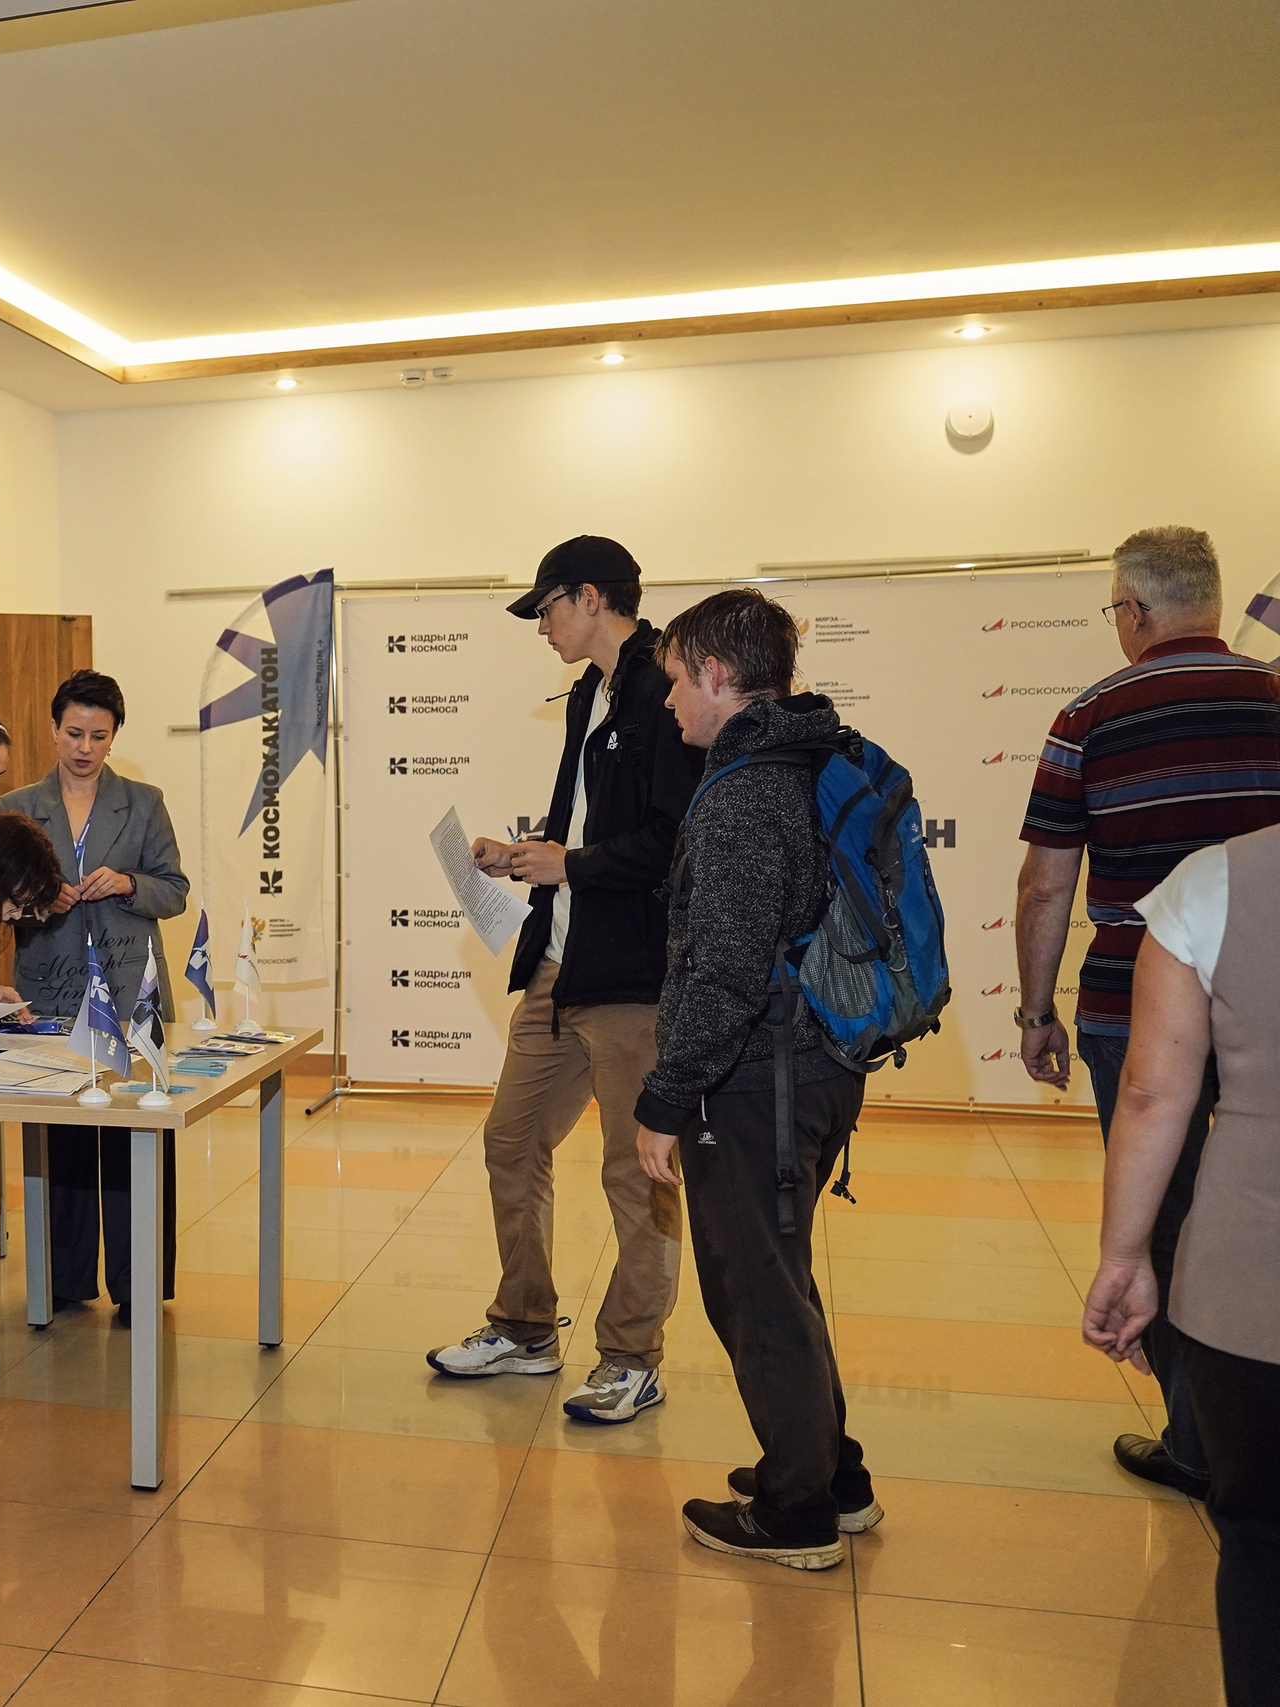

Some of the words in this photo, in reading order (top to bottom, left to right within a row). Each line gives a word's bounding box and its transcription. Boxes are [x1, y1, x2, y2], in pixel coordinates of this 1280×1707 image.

[1011, 619, 1088, 629] РОСКОСМОС
[411, 634, 445, 643] кадры
[448, 634, 468, 642] для
[412, 696, 446, 704] кадры
[449, 695, 469, 703] для
[261, 646, 282, 859] КОСМОХАКАТОН
[413, 757, 447, 766] кадры
[450, 757, 469, 765] для
[414, 910, 448, 918] кадры
[415, 971, 449, 979] кадры
[415, 1031, 449, 1039] кадры
